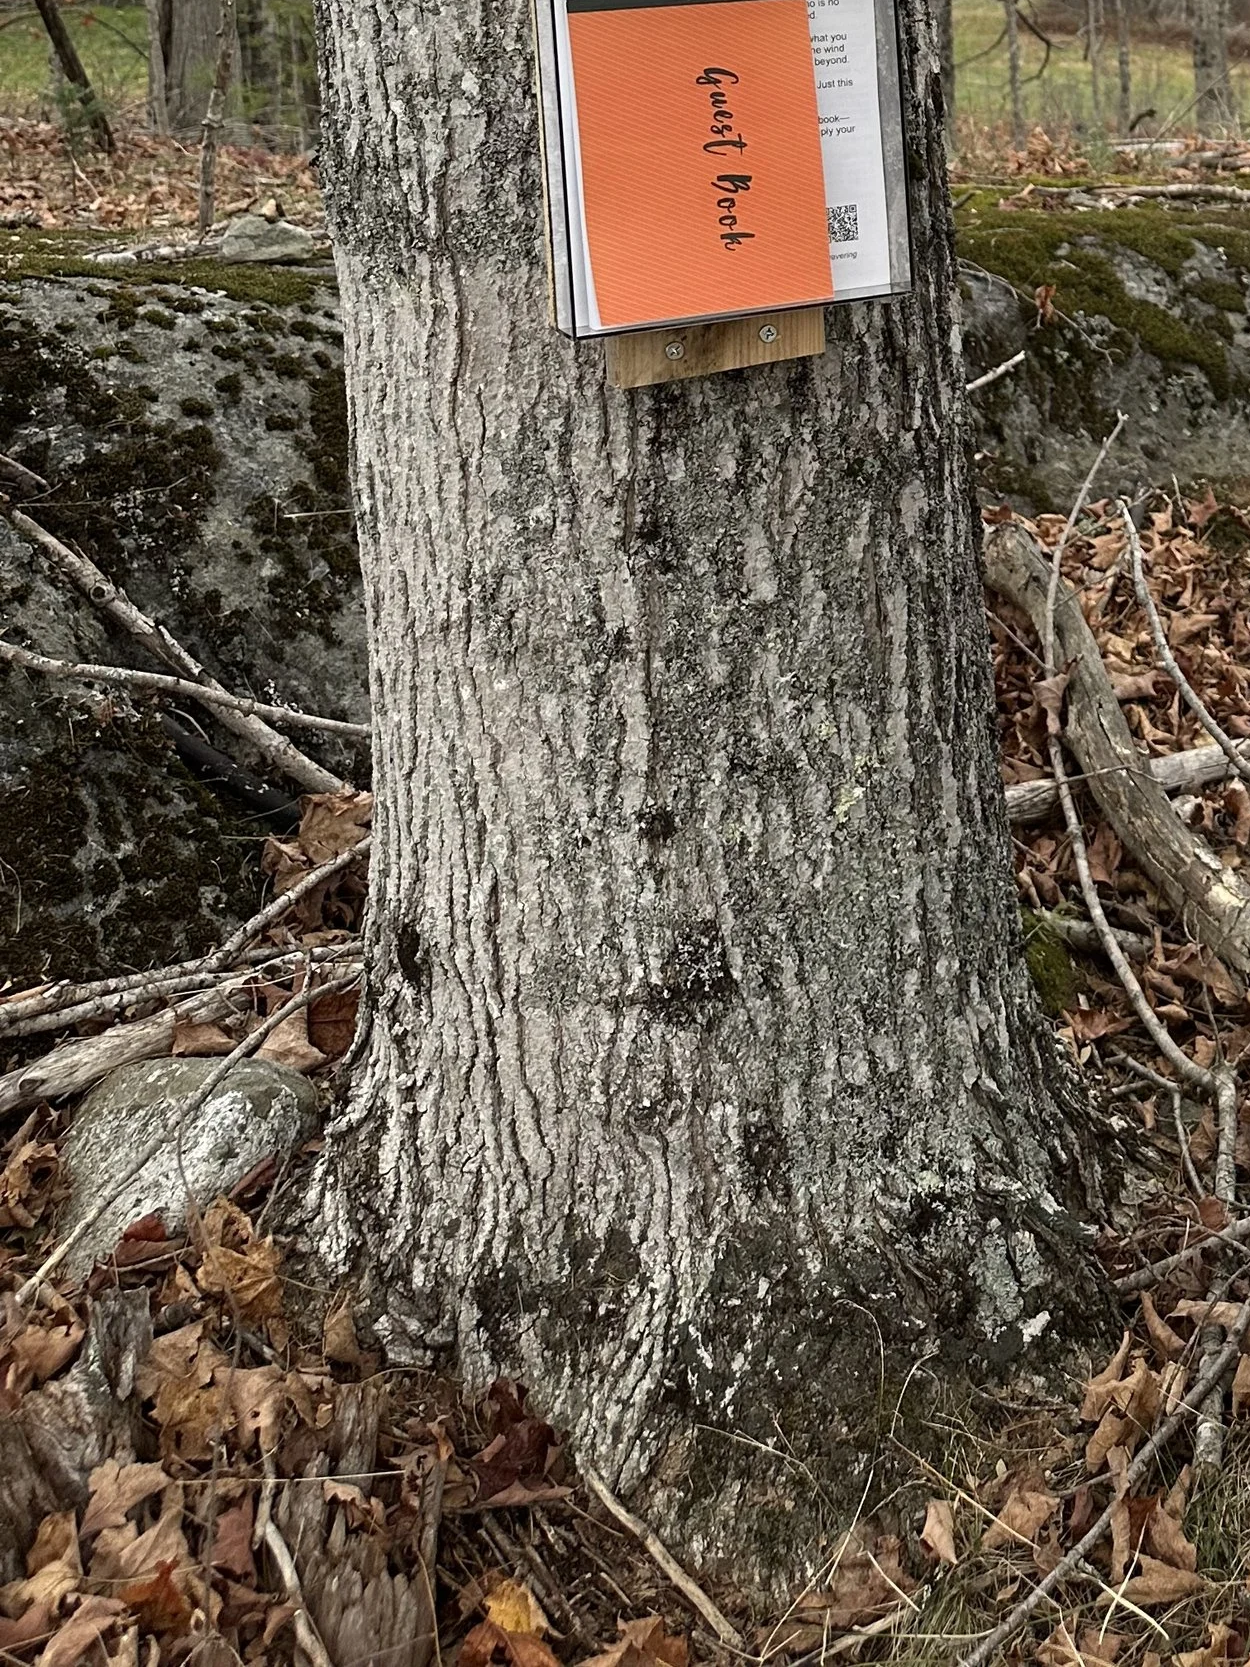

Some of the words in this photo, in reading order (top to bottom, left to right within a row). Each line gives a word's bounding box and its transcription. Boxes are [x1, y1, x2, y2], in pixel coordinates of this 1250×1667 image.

[831, 34, 847, 43] you
[824, 44, 845, 53] wind
[817, 79, 835, 89] Just
[837, 78, 853, 87] this
[696, 67, 748, 156] Guest
[836, 125, 855, 135] your
[711, 174, 756, 251] Book
